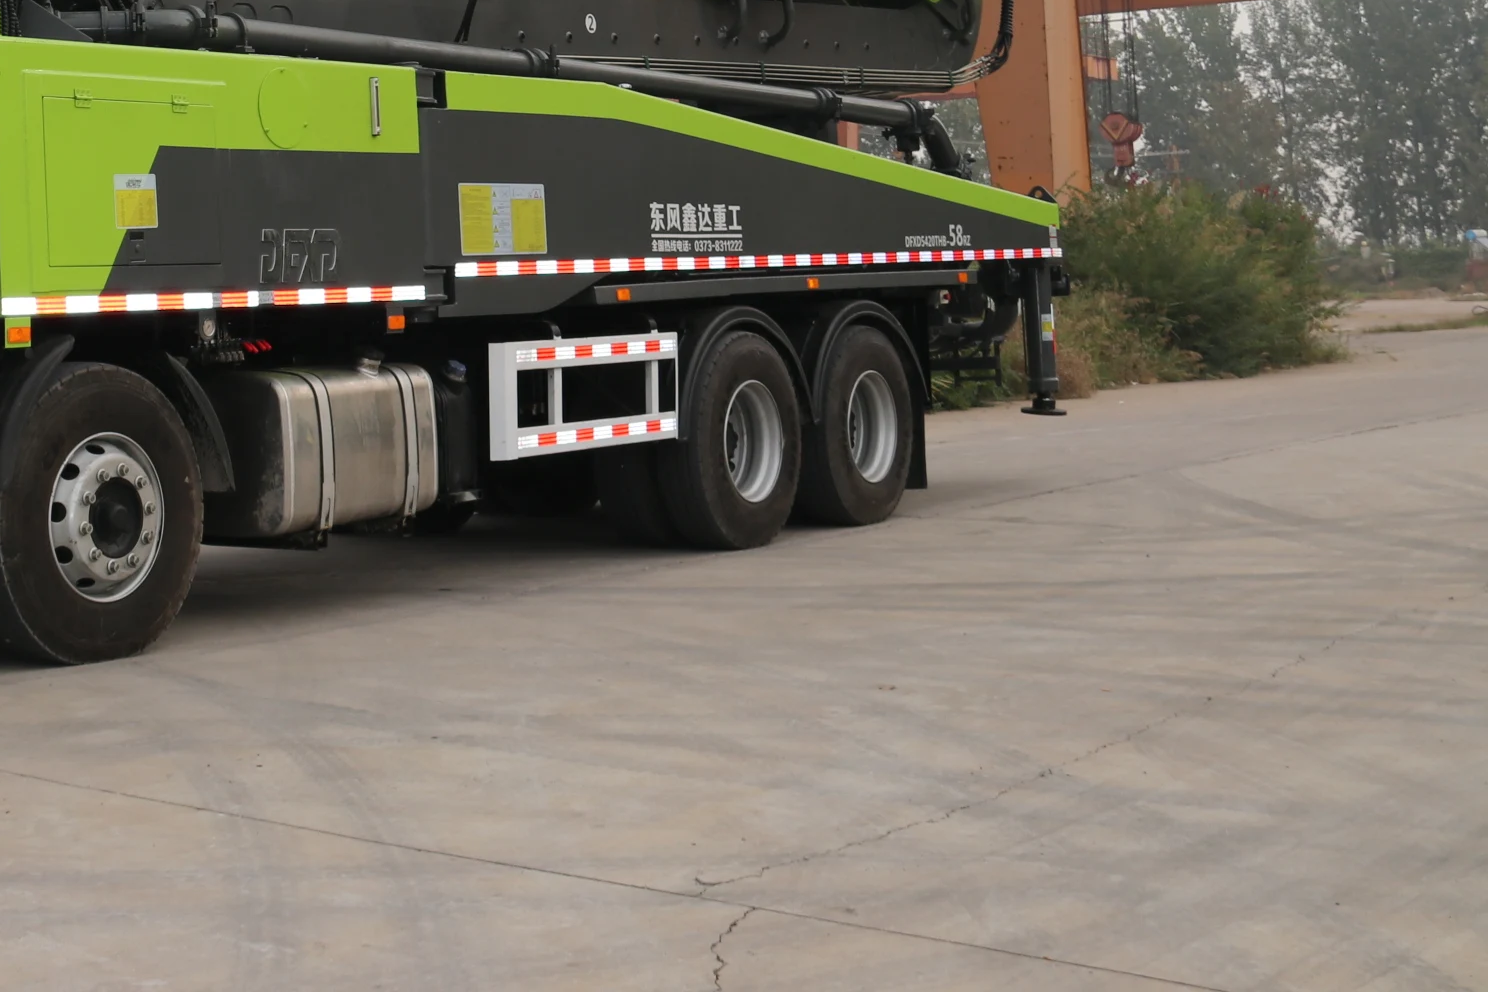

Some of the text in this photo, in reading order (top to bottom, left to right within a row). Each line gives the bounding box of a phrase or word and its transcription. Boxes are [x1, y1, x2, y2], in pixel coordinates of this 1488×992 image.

[649, 202, 742, 232] 东风鑫达重工
[694, 239, 743, 252] 0373-8311222
